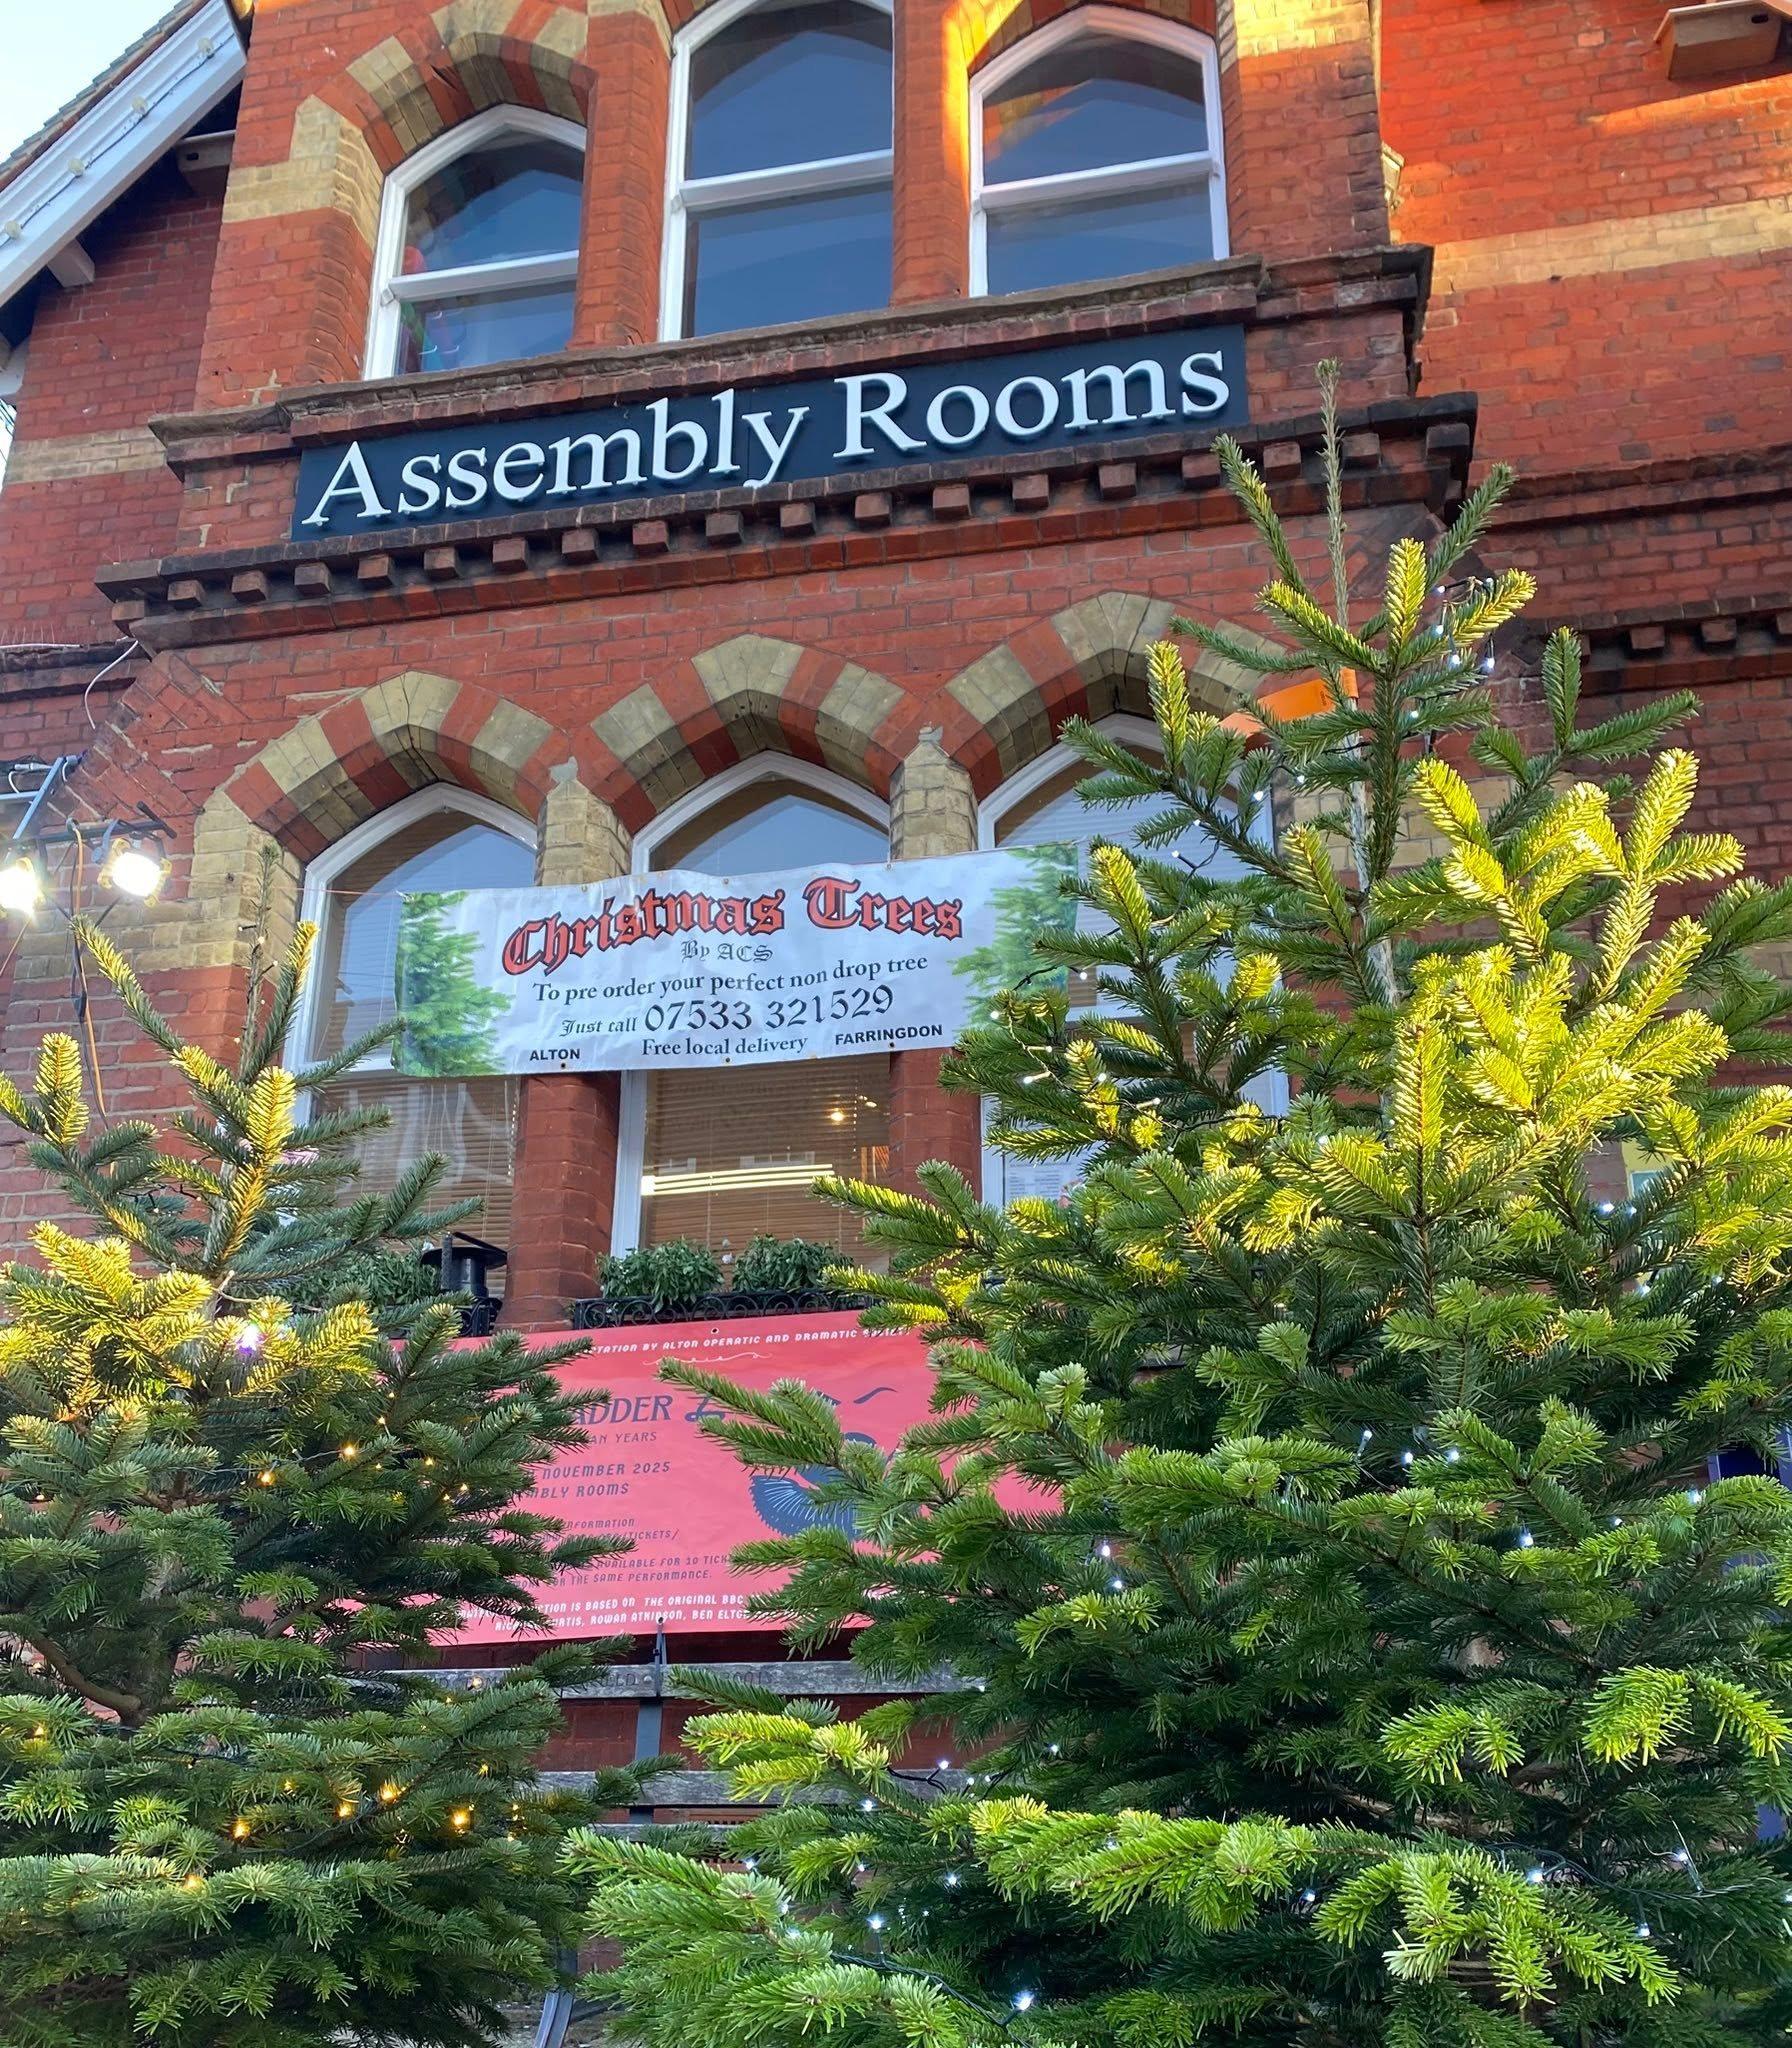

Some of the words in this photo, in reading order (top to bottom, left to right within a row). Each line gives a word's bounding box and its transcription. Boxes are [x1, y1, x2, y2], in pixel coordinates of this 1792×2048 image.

[301, 387, 811, 526] Assembly
[832, 349, 1231, 458] Rooms
[501, 887, 787, 978] Christmas
[802, 875, 964, 942] Trees
[681, 938, 710, 963] By
[717, 941, 774, 963] ACS
[532, 982, 561, 1002] To
[564, 986, 597, 1006] pre
[603, 977, 657, 998] order
[659, 975, 706, 999] your
[710, 972, 786, 996] perfect
[788, 969, 828, 988] non
[832, 959, 882, 981] drop
[887, 956, 929, 974] tree
[558, 1018, 603, 1038] Just
[607, 1016, 639, 1033] call
[643, 999, 754, 1032] 07533
[765, 983, 894, 1030] 321529
[834, 1023, 943, 1046] FARRINGDON
[529, 1047, 582, 1061] ALTON
[641, 1037, 682, 1056] Free
[686, 1037, 731, 1056] local
[735, 1036, 809, 1055] delivery
[591, 1345, 638, 1354] TATION
[642, 1342, 659, 1351] BY
[662, 1340, 699, 1350] ALTON
[703, 1336, 761, 1347] OPERATIC
[765, 1334, 790, 1344] AND
[795, 1330, 858, 1342] DRAMATIC
[573, 1394, 674, 1425] ADDER
[615, 1431, 657, 1444] YEARS
[542, 1463, 625, 1480] NOVEMBER
[632, 1461, 671, 1475] 2025
[525, 1486, 569, 1500] MBLY
[576, 1482, 629, 1498] ROOMS
[566, 1518, 635, 1530] NFORMATION
[660, 1556, 681, 1567] FOR
[686, 1556, 701, 1566] 10
[703, 1554, 730, 1565] TICK
[571, 1574, 589, 1585] THE
[593, 1572, 624, 1583] SAME
[627, 1569, 713, 1582] PERFORMANCE.
[571, 1601, 581, 1612] IS
[586, 1598, 618, 1611] BASED
[622, 1597, 636, 1608] ON
[644, 1596, 664, 1608] THE
[667, 1594, 718, 1606] ORIGINAL
[722, 1594, 744, 1605] BBC
[590, 1612, 627, 1625] ROWAN
[691, 1609, 714, 1620] BEN
